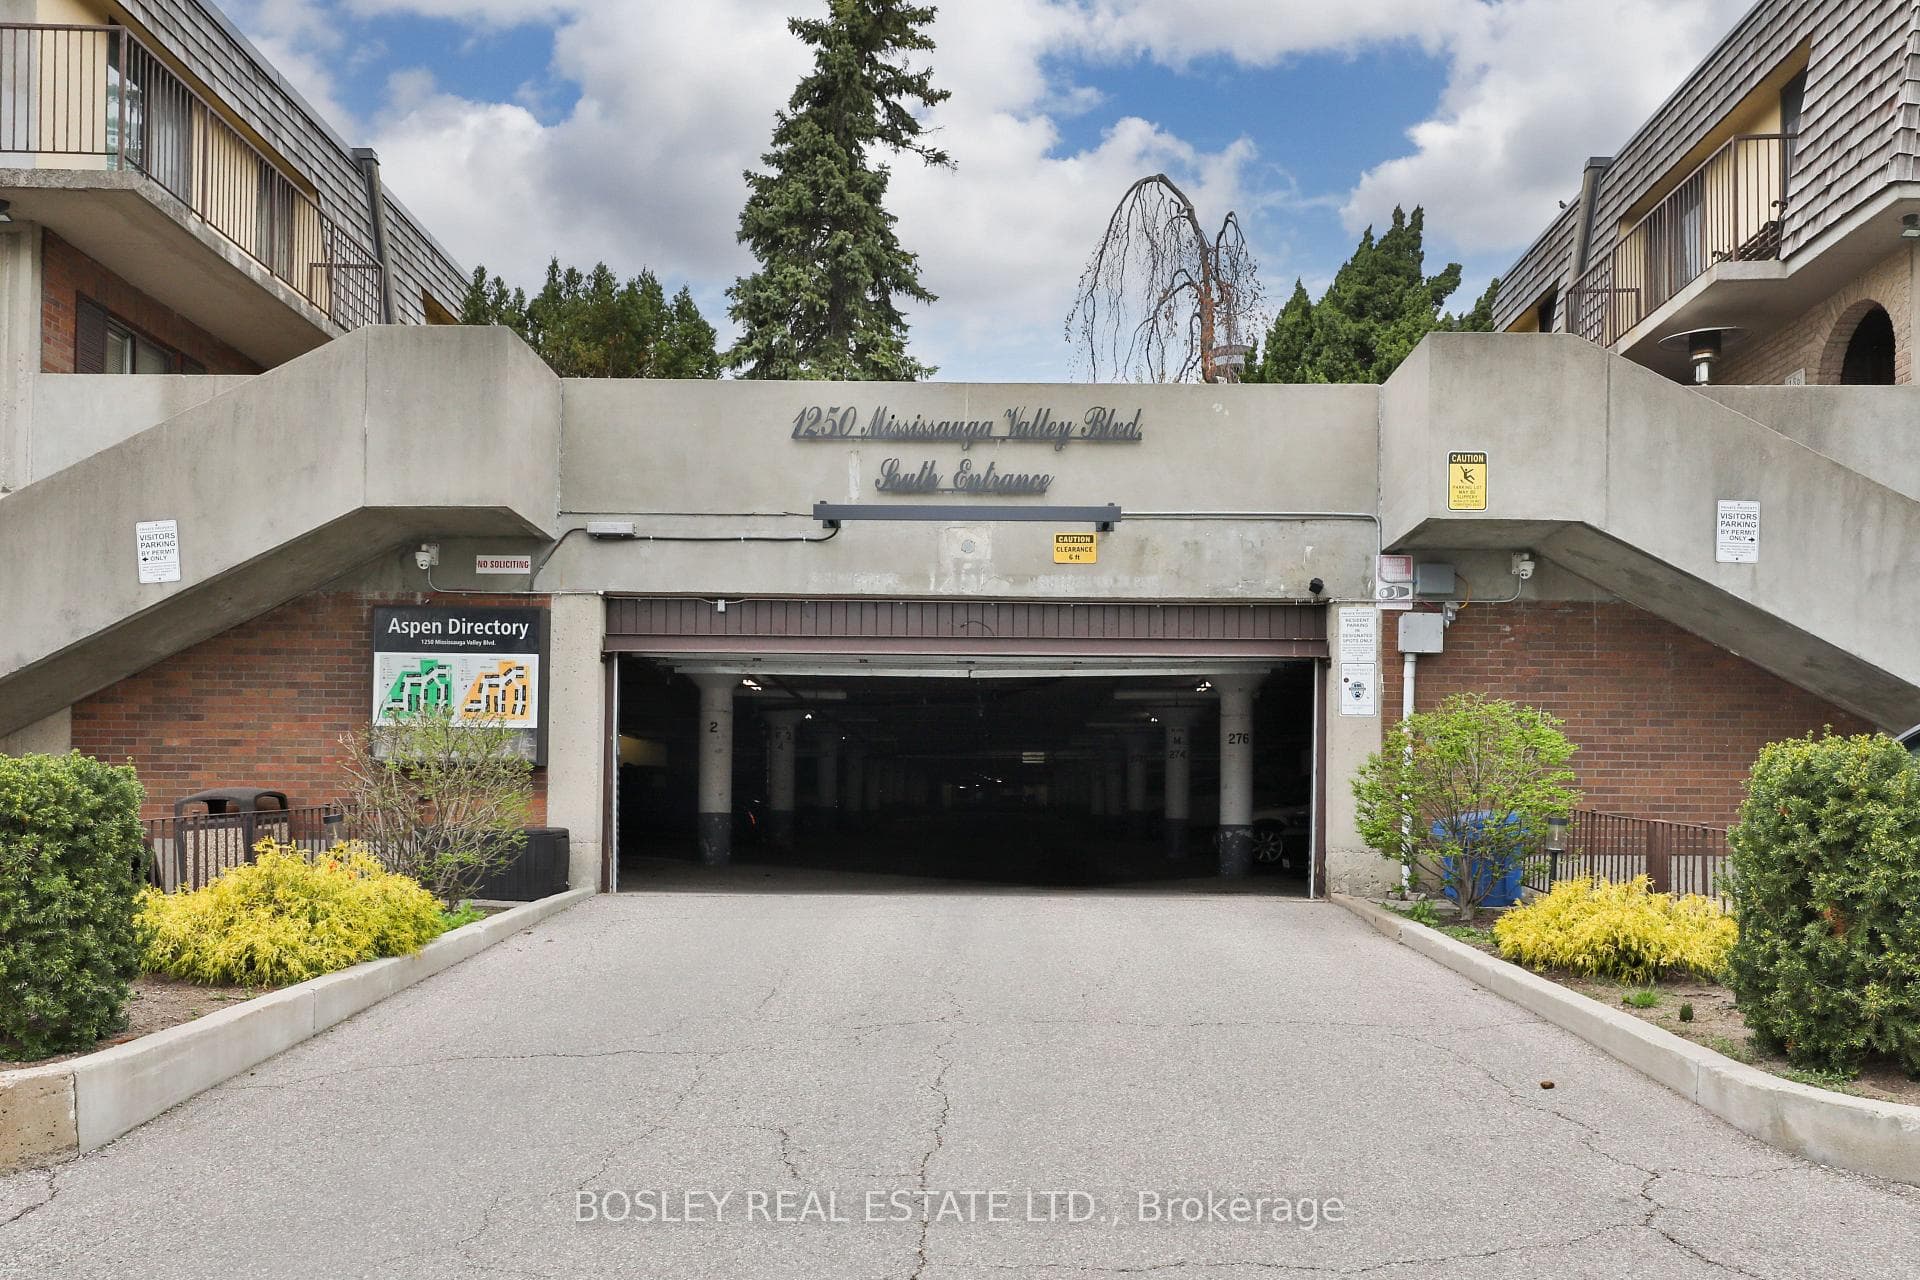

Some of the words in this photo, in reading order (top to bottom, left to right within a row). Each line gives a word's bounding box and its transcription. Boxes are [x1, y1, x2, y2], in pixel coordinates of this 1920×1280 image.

[791, 406, 857, 439] 1250
[860, 406, 994, 451] Mississauga
[1003, 406, 1078, 451] Valley
[1451, 454, 1484, 463] CAUTION
[875, 458, 942, 492] South
[953, 458, 1055, 493] Entrance
[139, 532, 176, 541] VISITORS
[140, 540, 176, 549] PARKING
[478, 560, 488, 568] NO
[490, 560, 529, 568] SOLICITING
[388, 617, 442, 638] Aspen
[448, 618, 529, 639] Directory
[435, 639, 465, 647] Mississauga
[466, 639, 482, 647] Valley
[709, 722, 718, 733] 2
[1228, 733, 1249, 744] 276
